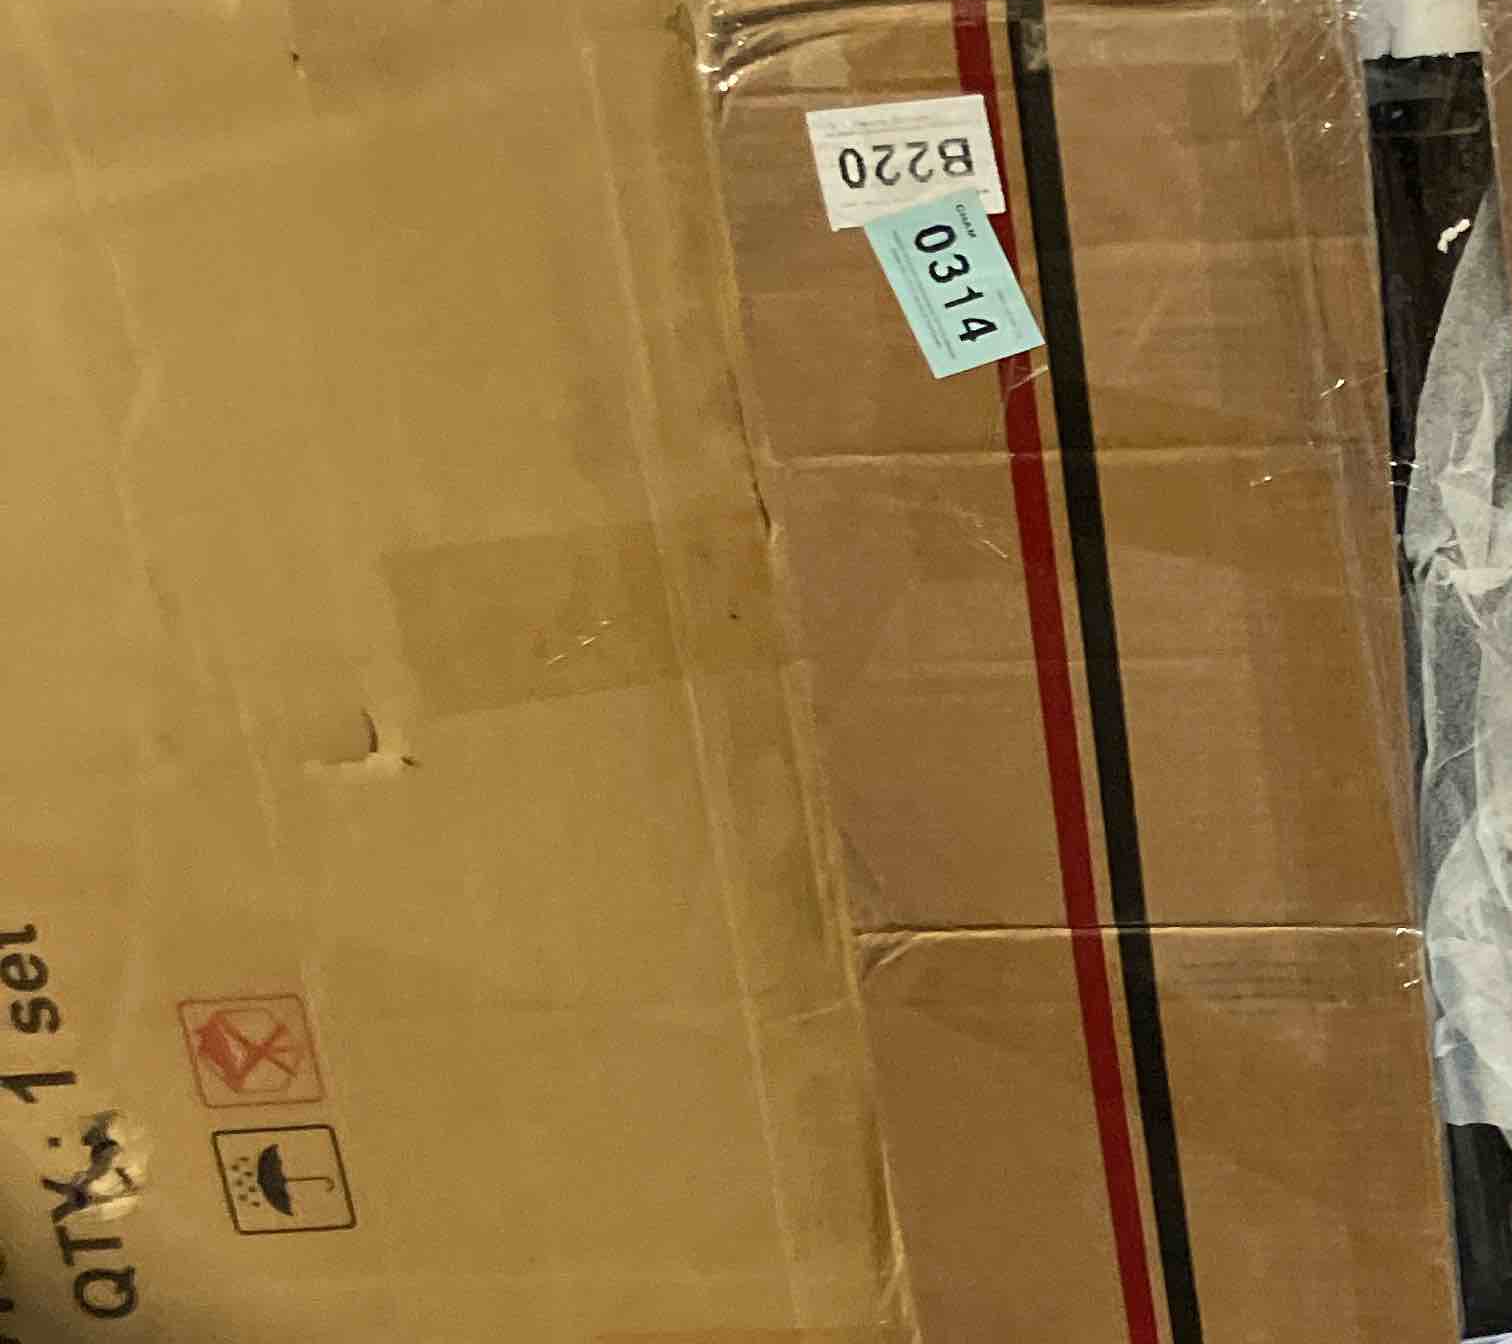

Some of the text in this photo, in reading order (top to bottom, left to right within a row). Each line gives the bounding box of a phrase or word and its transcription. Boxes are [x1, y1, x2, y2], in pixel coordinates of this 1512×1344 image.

[838, 136, 976, 190] B220
[913, 223, 999, 343] 0314
[0, 1070, 77, 1105] 1
